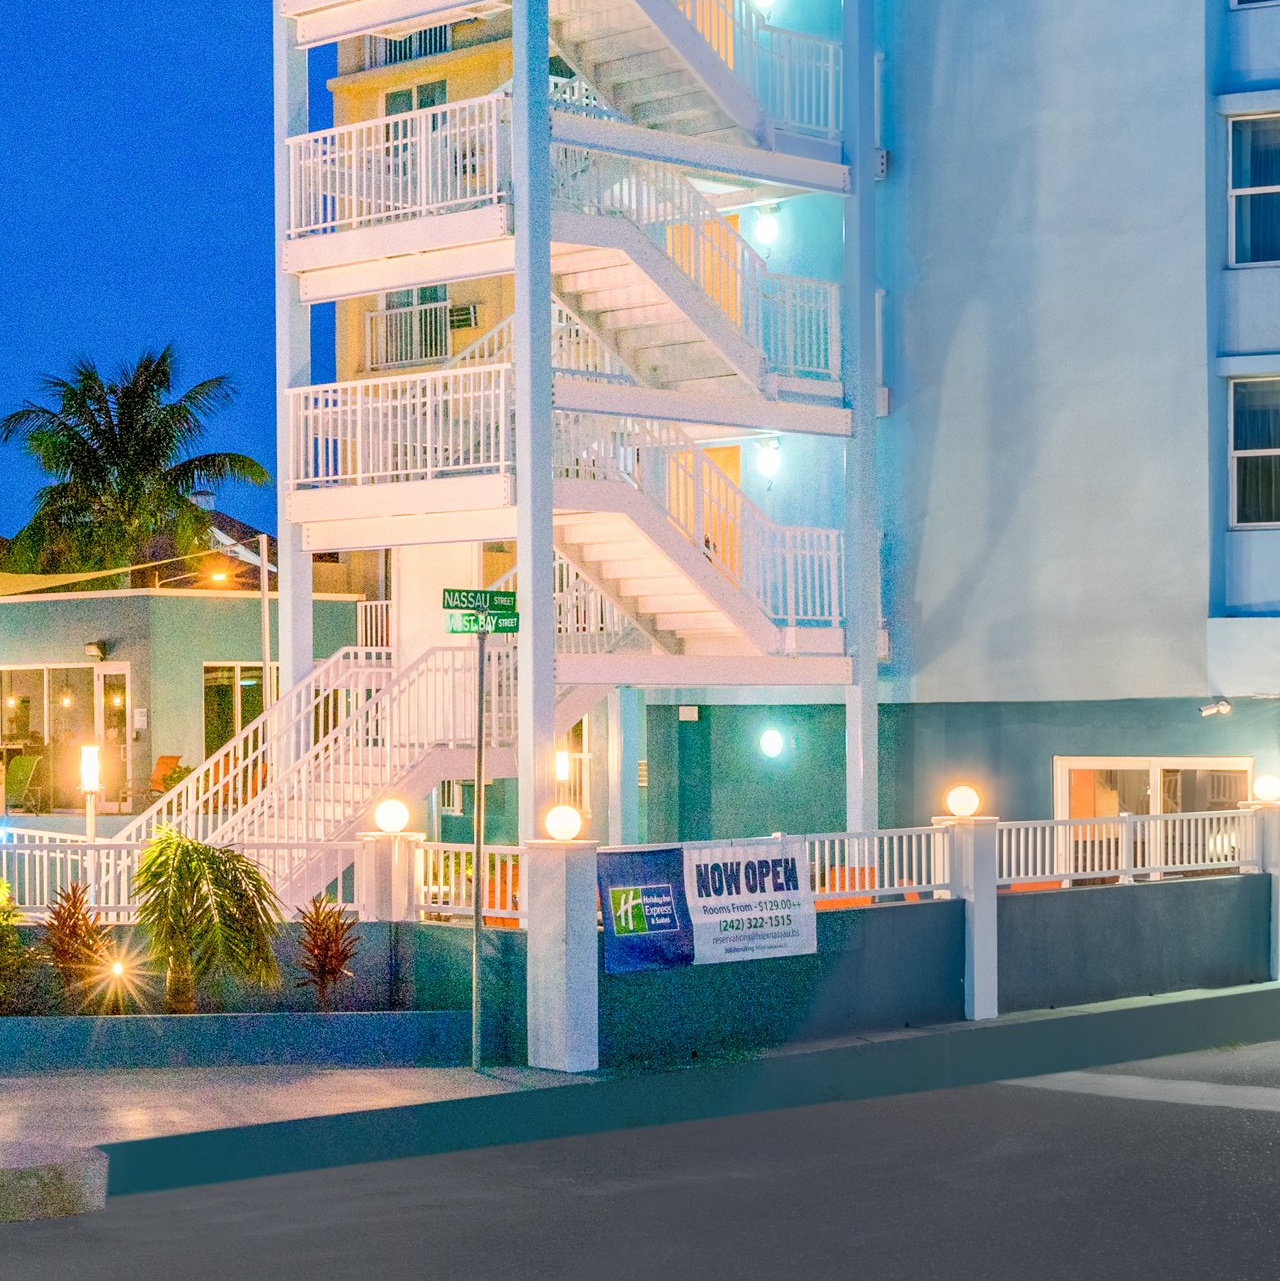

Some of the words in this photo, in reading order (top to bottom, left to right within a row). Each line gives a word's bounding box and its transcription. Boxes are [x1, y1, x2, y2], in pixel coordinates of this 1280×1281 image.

[444, 591, 490, 608] NASSAU
[493, 596, 515, 606] STREET
[478, 615, 498, 631] BAY
[498, 617, 518, 627] STREET
[695, 860, 742, 899] NOW
[744, 857, 800, 895] OPEN
[645, 905, 672, 917] Express
[702, 904, 731, 916] Rooms
[732, 902, 753, 914] From
[719, 917, 744, 933] (242)
[746, 914, 792, 930] 322-1515
